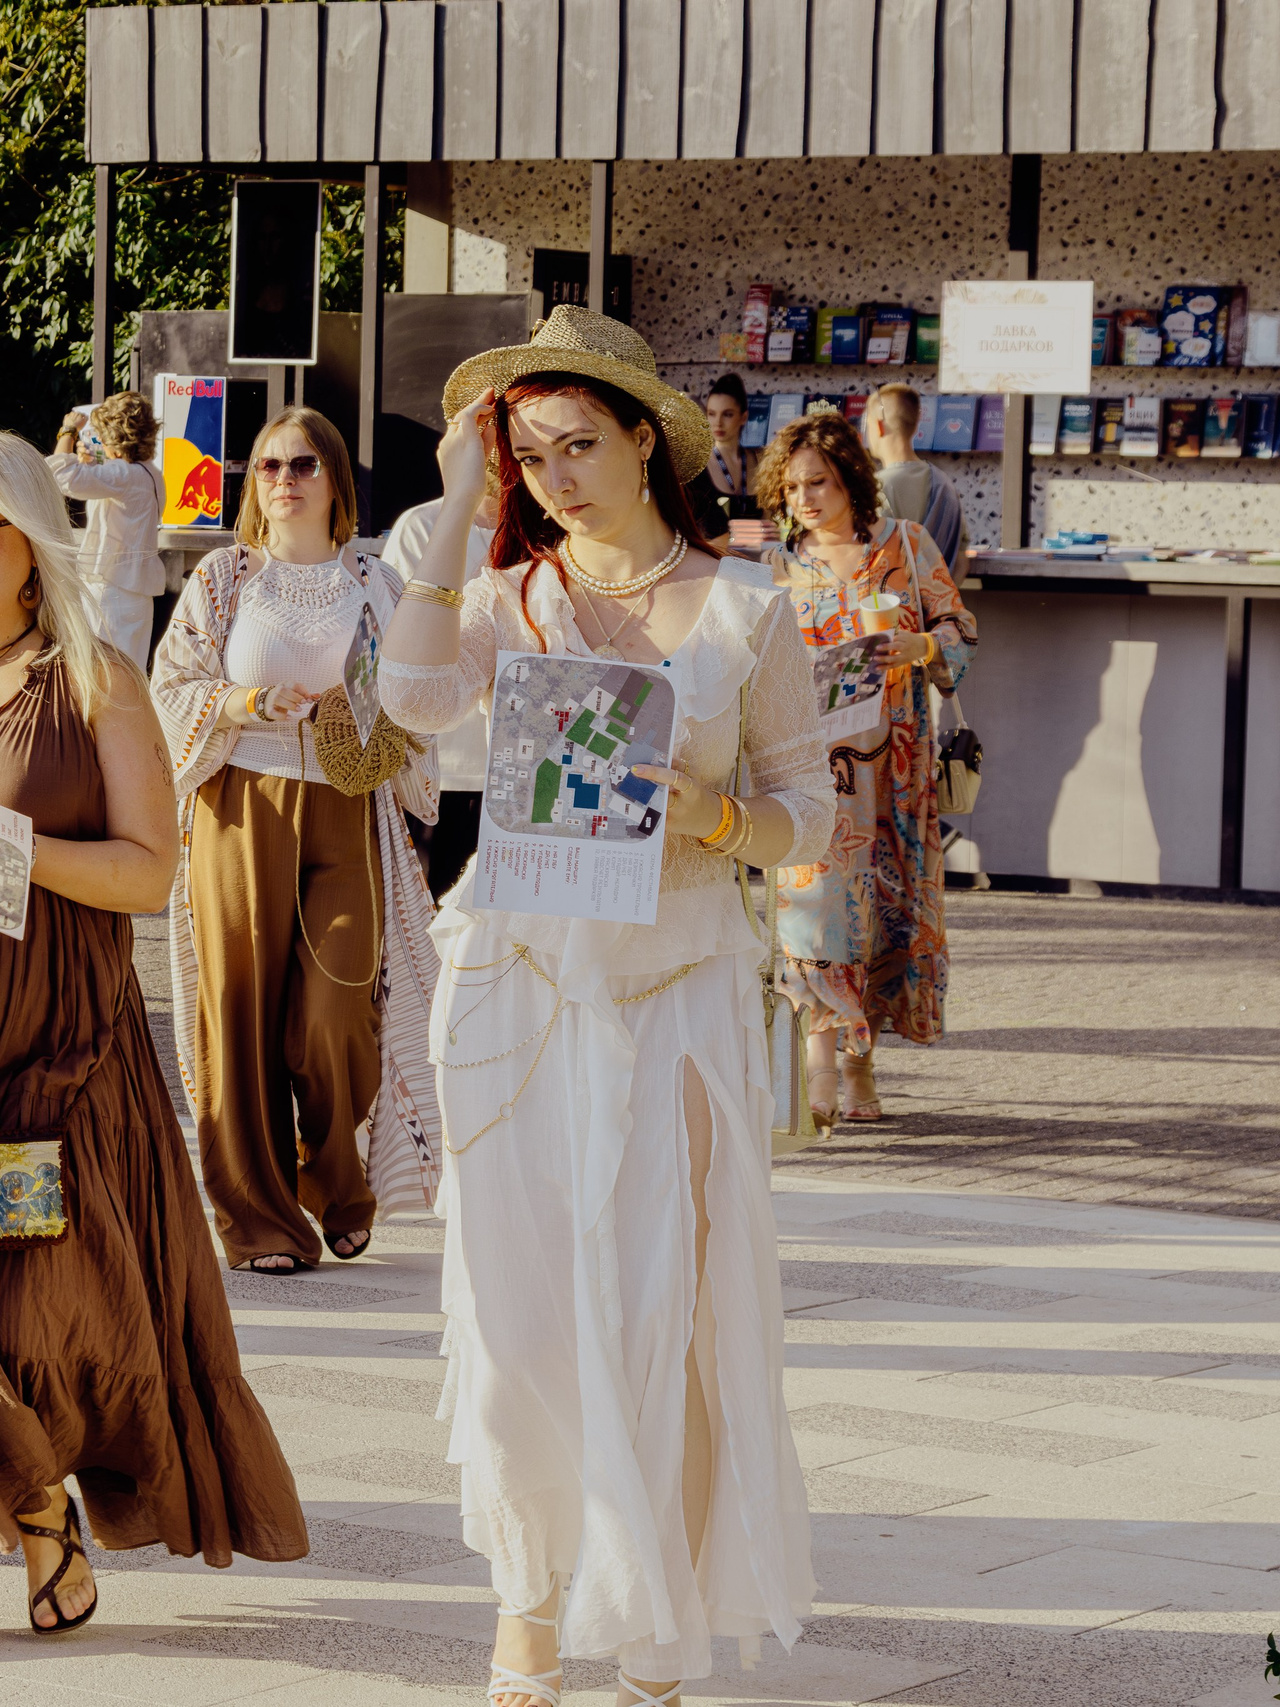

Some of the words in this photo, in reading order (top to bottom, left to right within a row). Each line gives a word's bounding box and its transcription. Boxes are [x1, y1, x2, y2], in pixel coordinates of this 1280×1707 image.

[553, 281, 619, 305] EMBAO
[993, 325, 1037, 337] ЛАВКА
[979, 340, 1054, 352] ПОДАРКОВ
[168, 380, 194, 396] Red
[195, 380, 223, 397] Bull
[513, 846, 521, 876] МЕДИТАЦИЯ
[552, 850, 557, 858] НА
[489, 869, 497, 902] ТРОГАТЕЛЬНО
[533, 870, 541, 896] МЕЛОДИЮ
